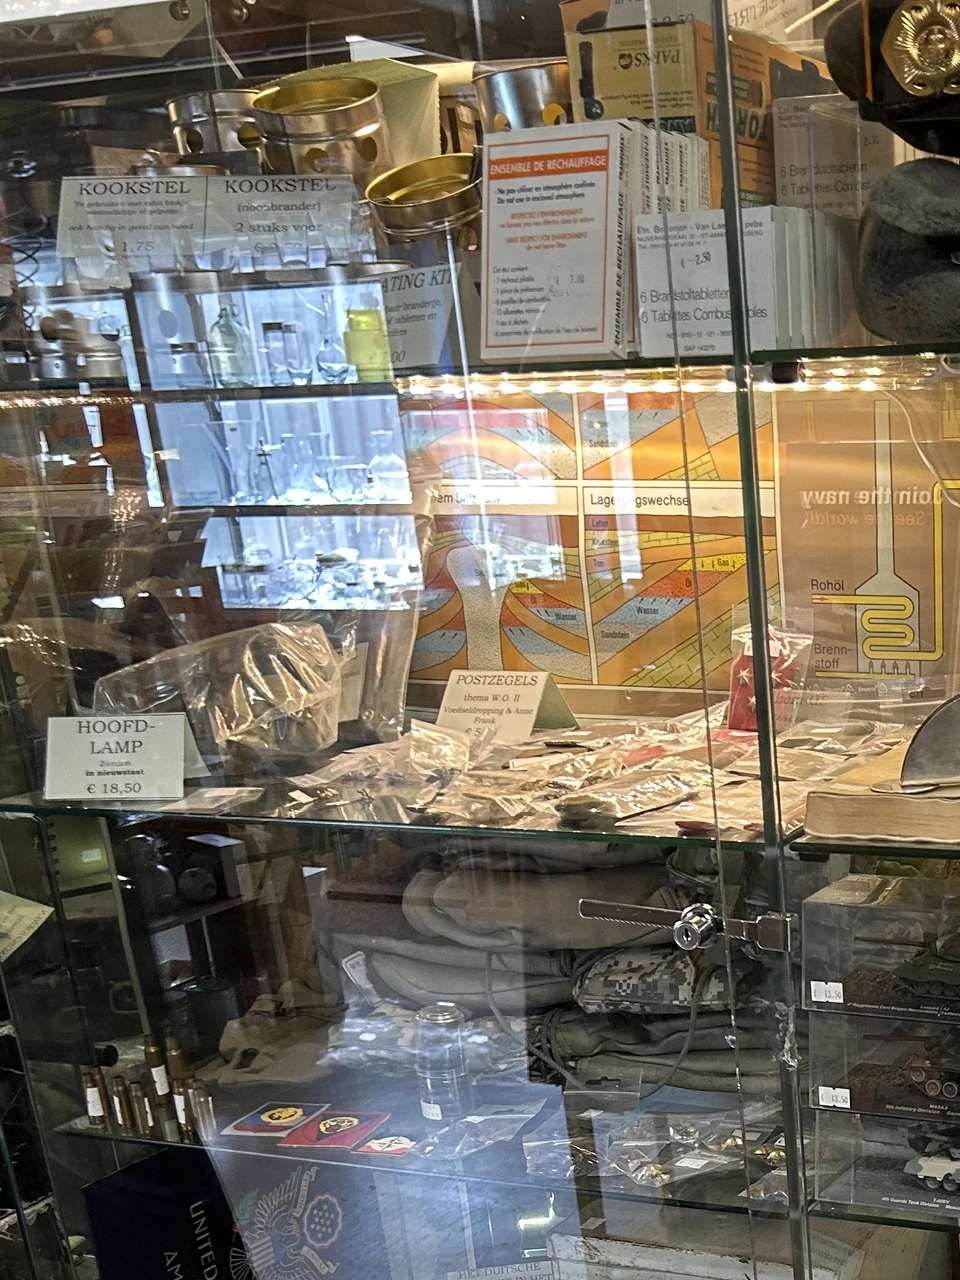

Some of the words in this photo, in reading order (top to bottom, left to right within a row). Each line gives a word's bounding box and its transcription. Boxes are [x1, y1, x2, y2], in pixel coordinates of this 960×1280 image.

[490, 161, 531, 175] ENSEMBLE
[533, 160, 544, 172] DE
[547, 155, 607, 170] RECHAUFFAGE
[79, 181, 190, 196] KOOKSTEL
[225, 178, 336, 194] KOOKSTEL
[810, 579, 845, 592] Rohöl
[554, 613, 578, 622] Wasser
[636, 606, 660, 616] Wasser
[814, 643, 852, 656] Brenn-
[814, 657, 840, 670] stoff
[456, 674, 539, 687] POSTZEGELS
[77, 719, 156, 734] HOOFD-
[90, 740, 143, 755] LAMP
[87, 783, 96, 795] €
[102, 783, 142, 795] 18,50
[459, 1268, 483, 1279] HET
[484, 1262, 541, 1277] DUITSCHE
